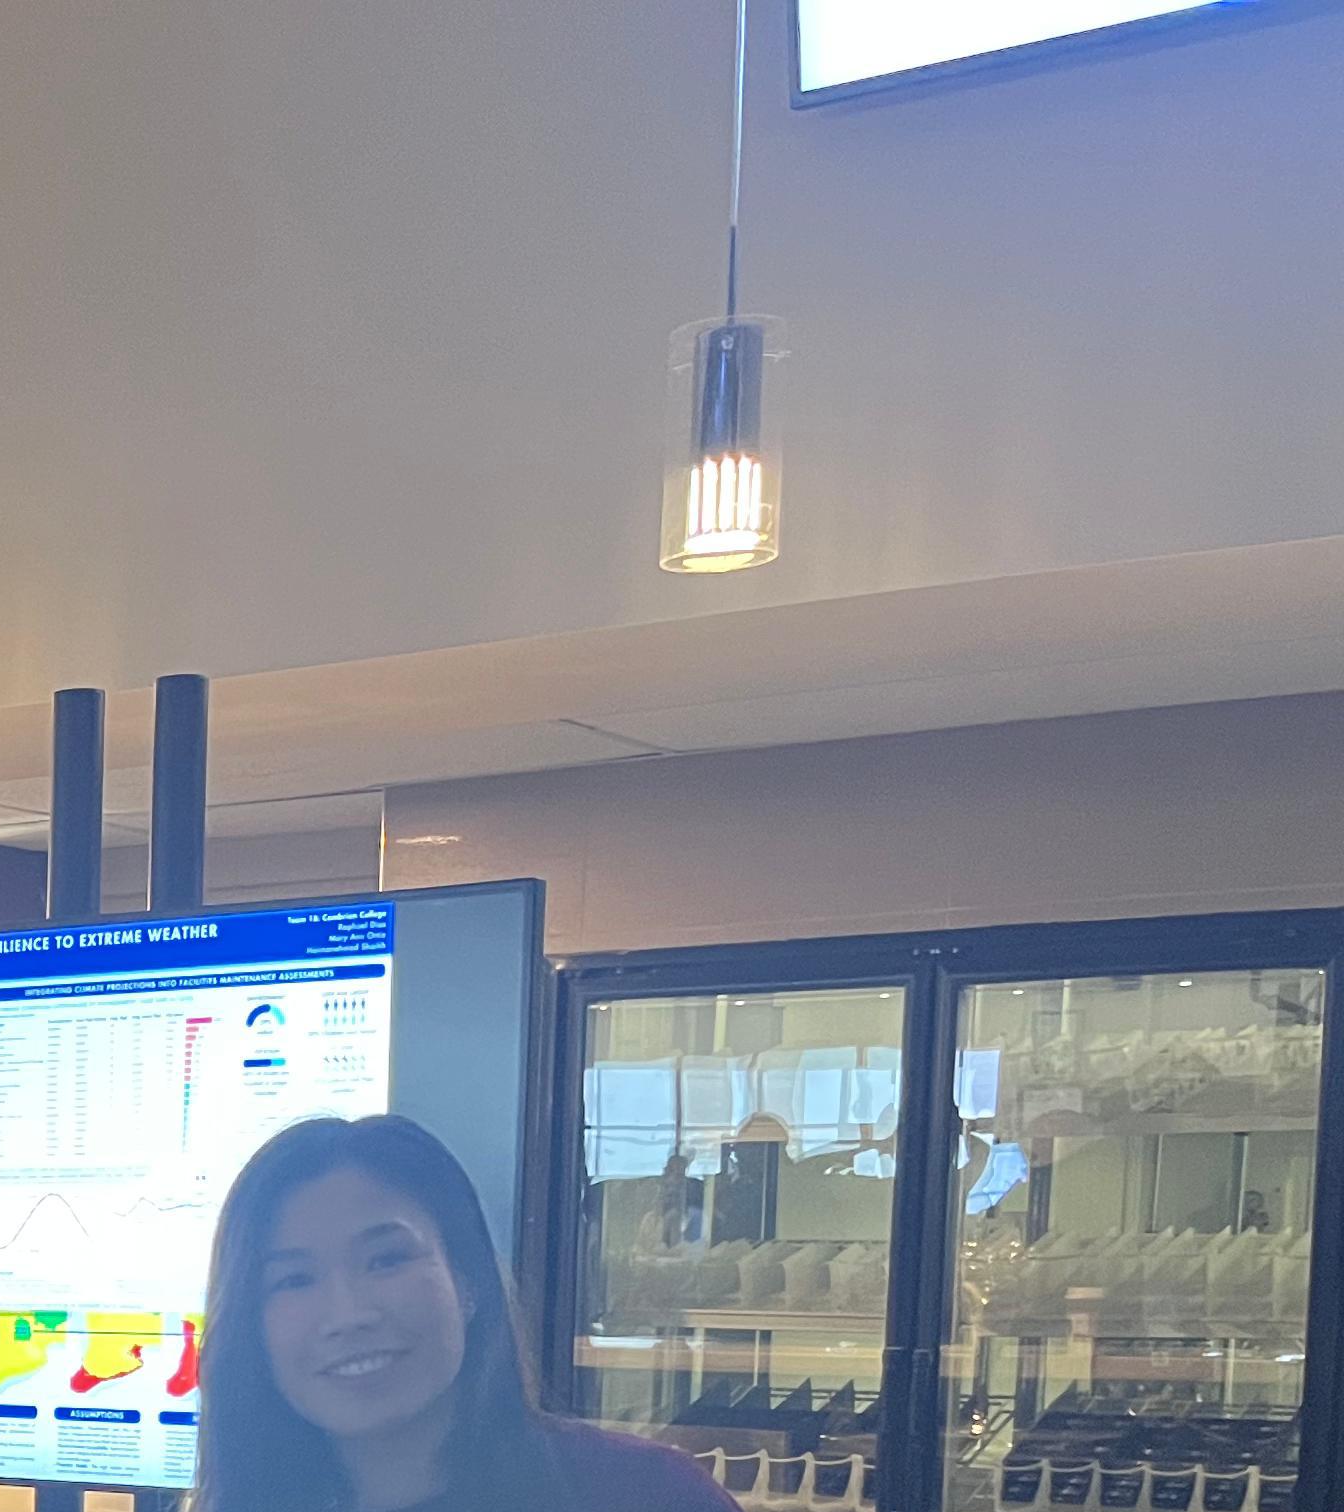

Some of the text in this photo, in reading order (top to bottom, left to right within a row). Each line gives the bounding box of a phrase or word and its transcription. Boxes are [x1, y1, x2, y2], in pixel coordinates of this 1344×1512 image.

[55, 934, 74, 950] TO
[79, 928, 142, 948] EXTREME
[147, 923, 219, 943] WEATHER
[74, 983, 105, 994] CLIMATE
[106, 980, 156, 992] PROJECTIONS
[158, 978, 177, 989] INTO
[178, 976, 217, 987] FACILITIES
[219, 972, 277, 984] MAINTENANCE
[278, 968, 335, 982] ASSESSMENTS
[70, 1408, 125, 1421] ASSUMPTIONS
